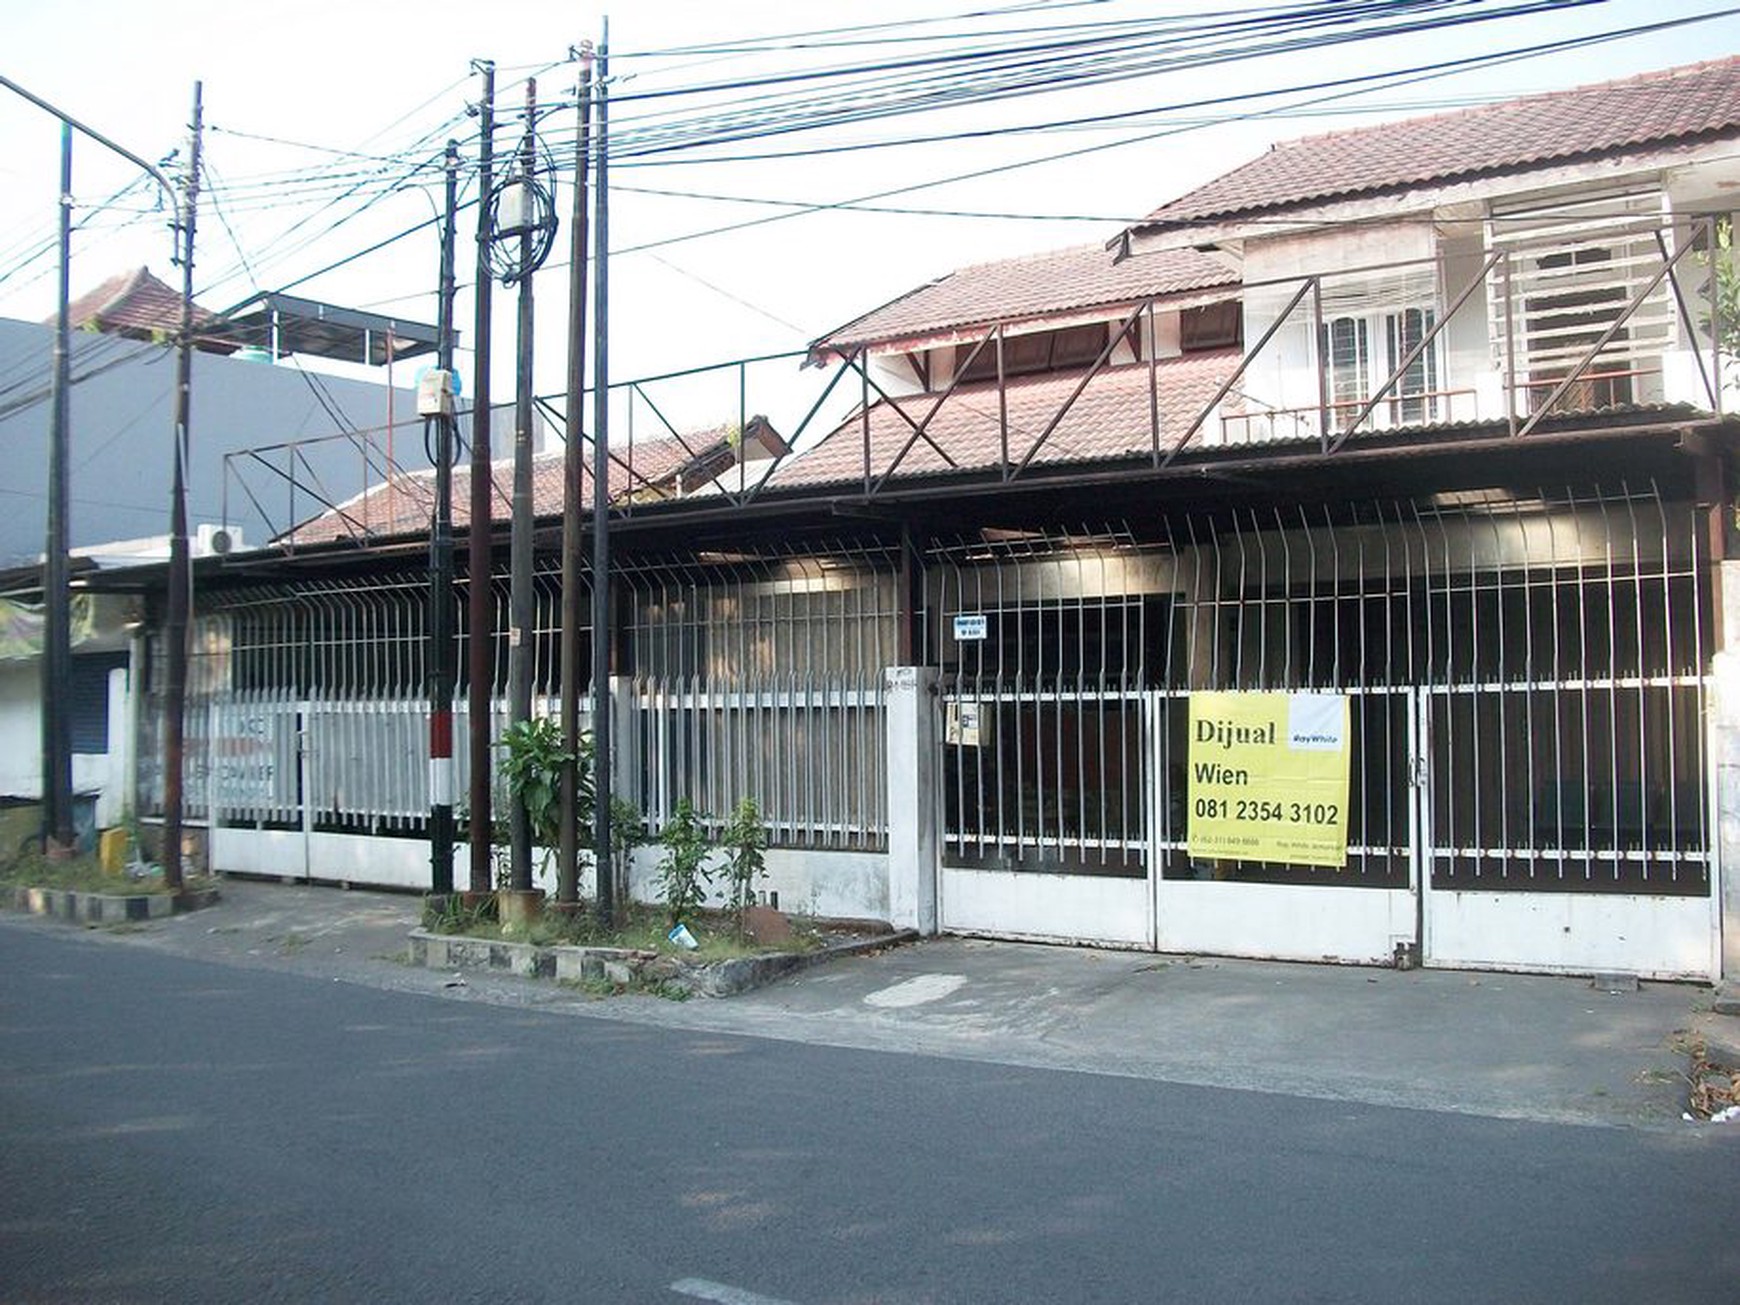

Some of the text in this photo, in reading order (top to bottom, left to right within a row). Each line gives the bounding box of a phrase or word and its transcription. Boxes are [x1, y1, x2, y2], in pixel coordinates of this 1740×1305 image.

[1196, 719, 1275, 749] Dijual
[1195, 763, 1248, 785] Wien
[1196, 798, 1338, 825] 081 2354 3102
